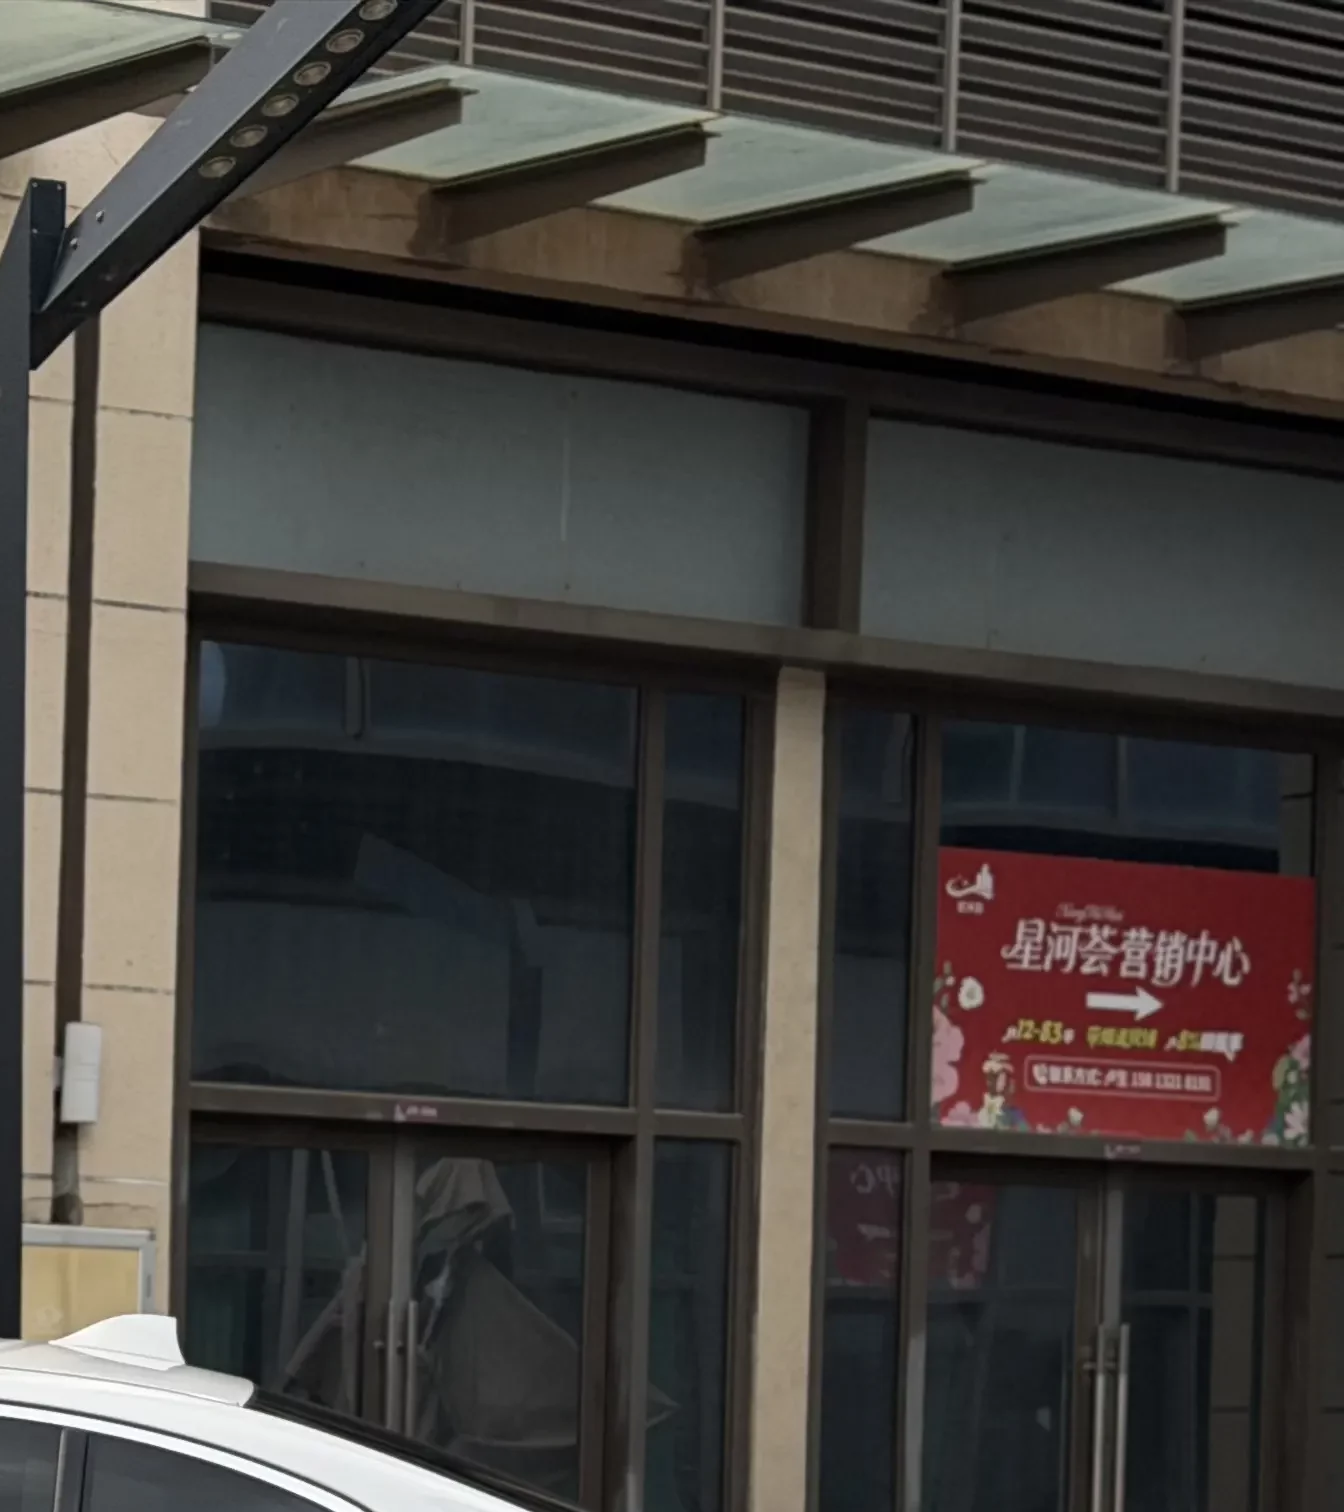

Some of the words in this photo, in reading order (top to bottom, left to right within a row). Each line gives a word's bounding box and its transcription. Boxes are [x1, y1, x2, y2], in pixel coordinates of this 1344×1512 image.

[1001, 918, 1251, 989] 星河荟营销中心
